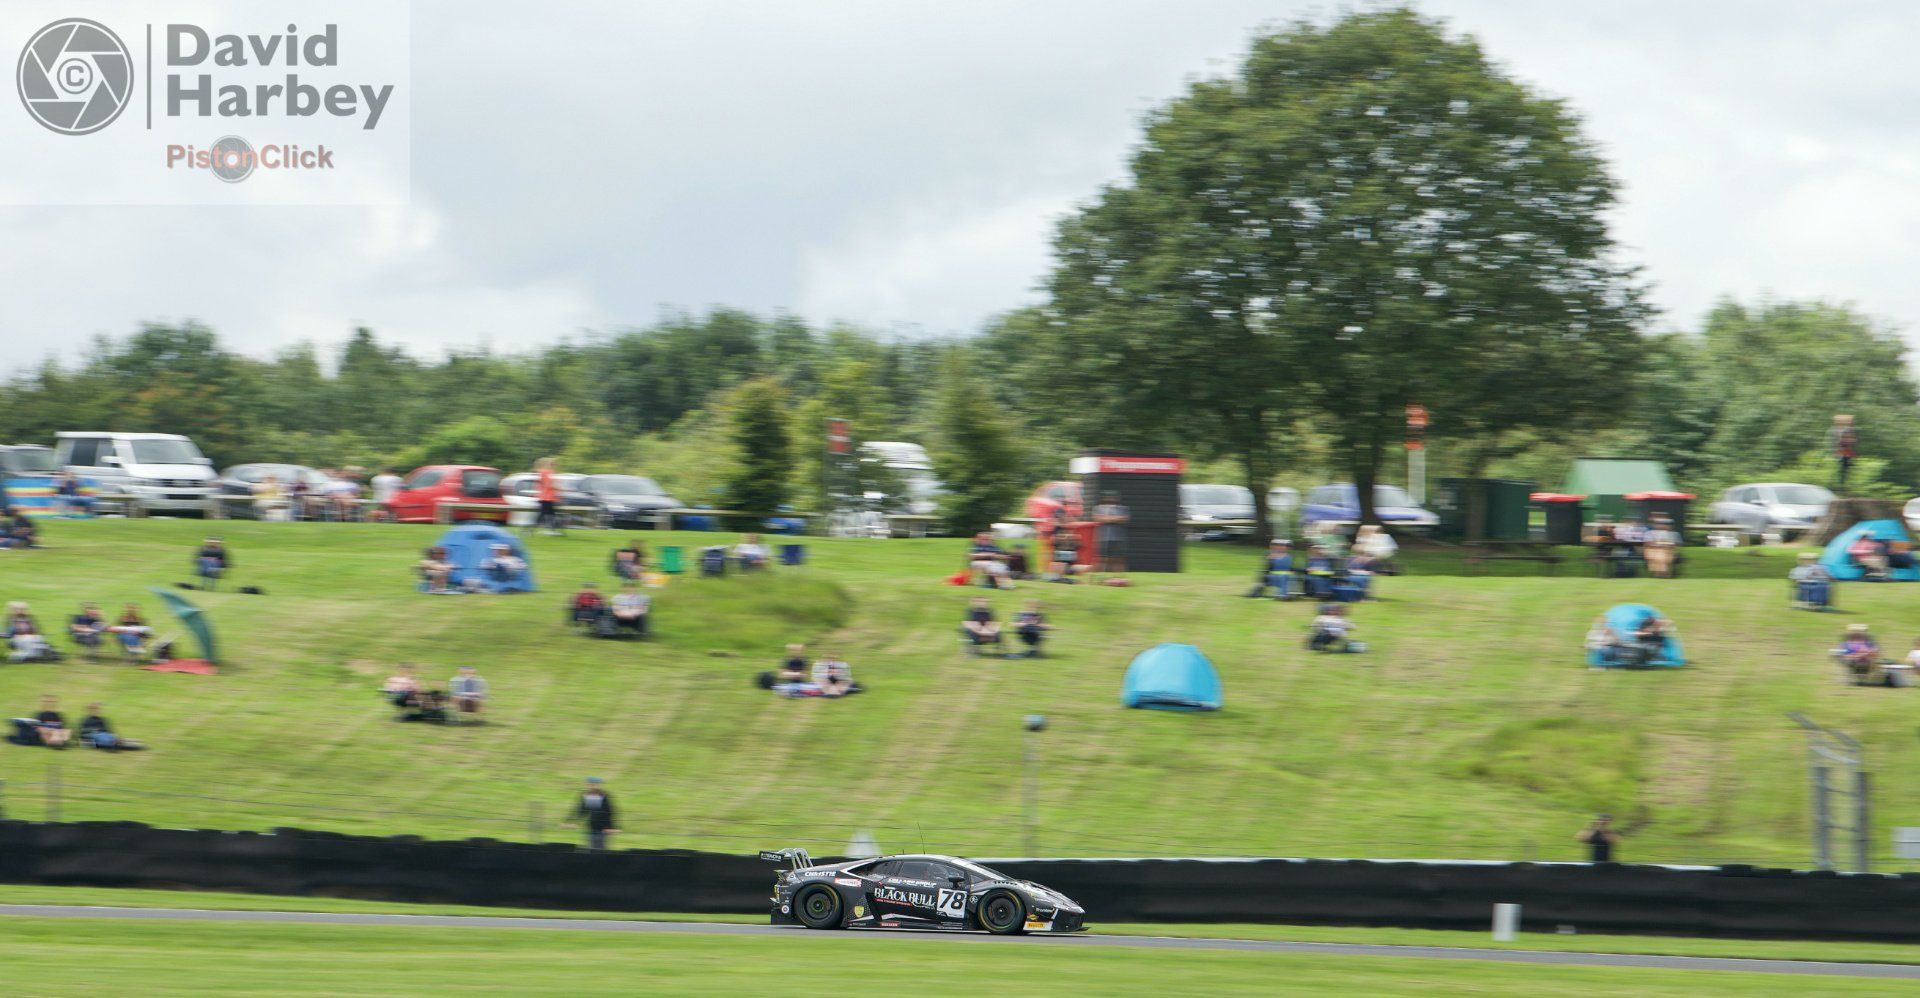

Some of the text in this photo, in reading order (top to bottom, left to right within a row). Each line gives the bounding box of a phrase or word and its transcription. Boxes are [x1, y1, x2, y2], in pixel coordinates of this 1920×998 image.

[874, 888, 907, 902] BLACK
[909, 892, 936, 907] BULL
[940, 890, 965, 910] 78
